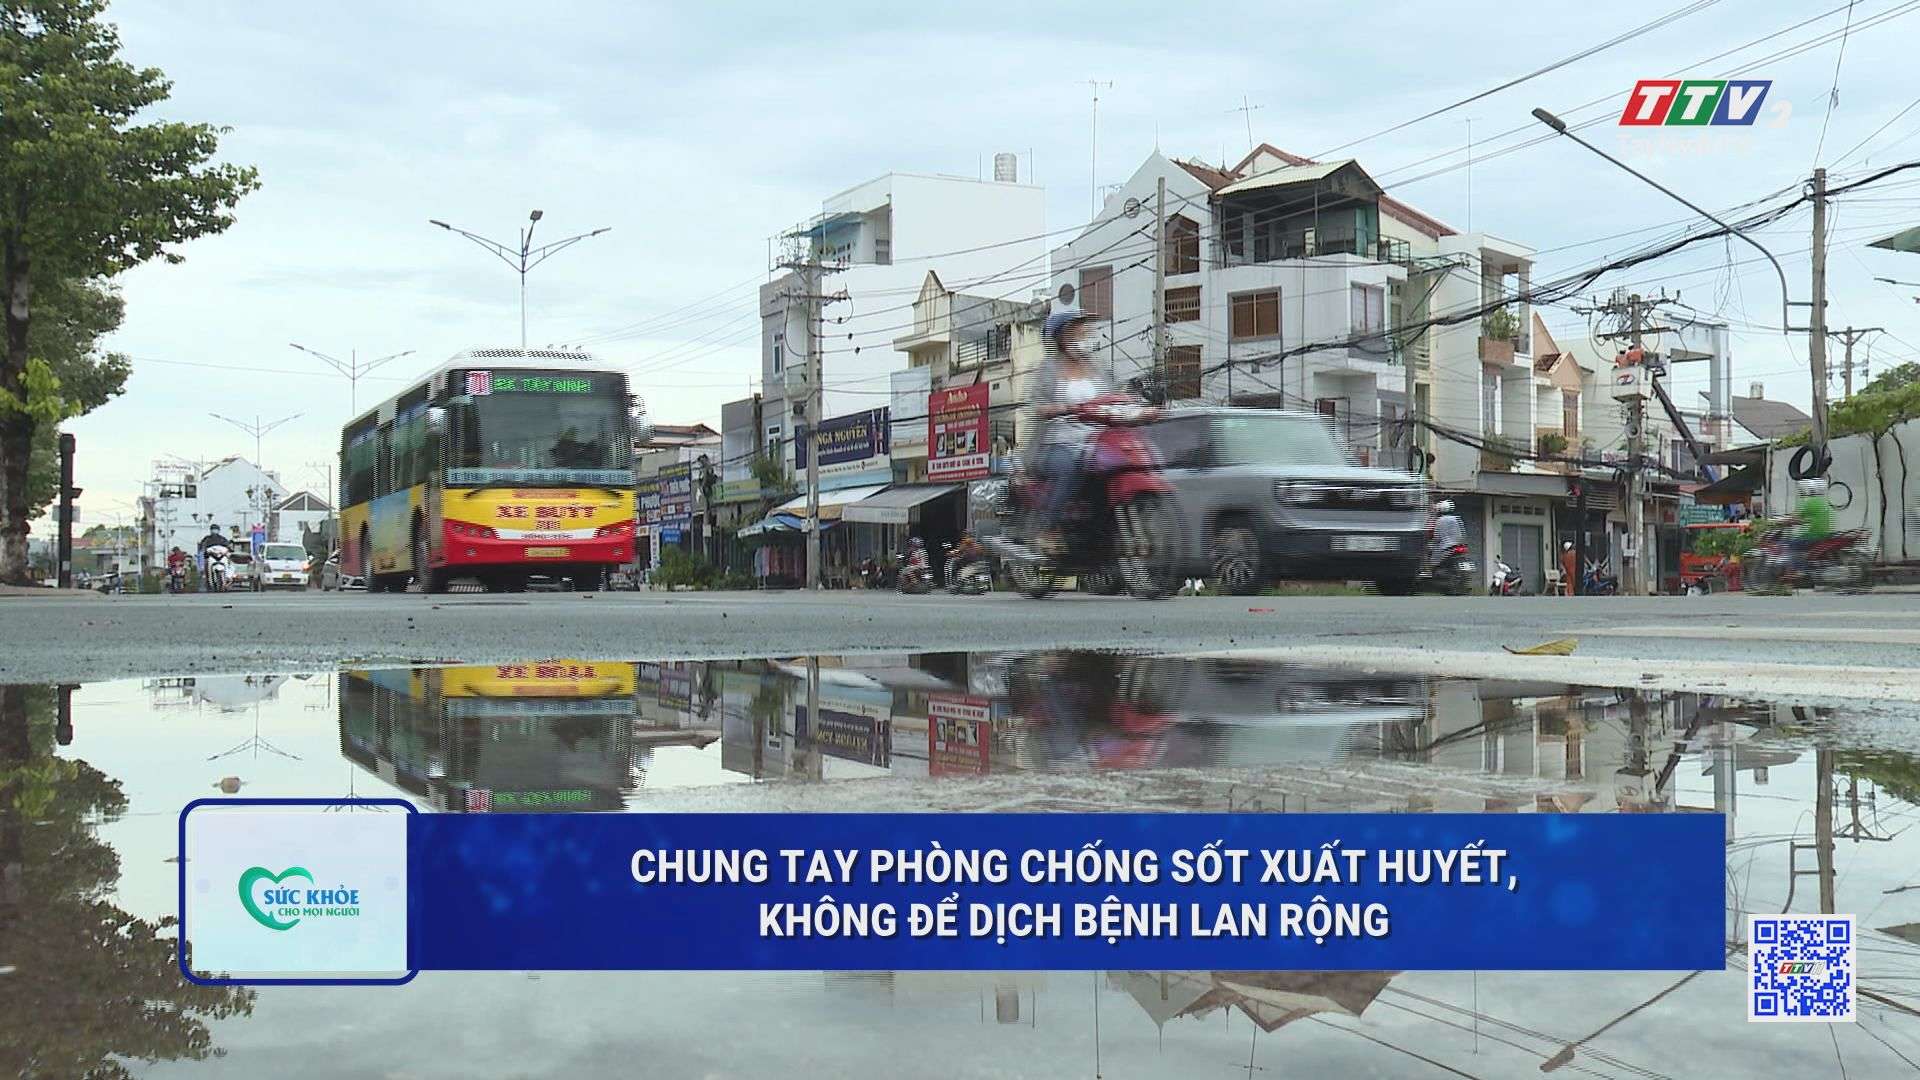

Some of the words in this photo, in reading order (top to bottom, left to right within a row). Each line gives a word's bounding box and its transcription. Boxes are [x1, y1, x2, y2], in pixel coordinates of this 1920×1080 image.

[468, 373, 491, 394] 701
[553, 378, 592, 393] NINH
[496, 506, 528, 518] XE
